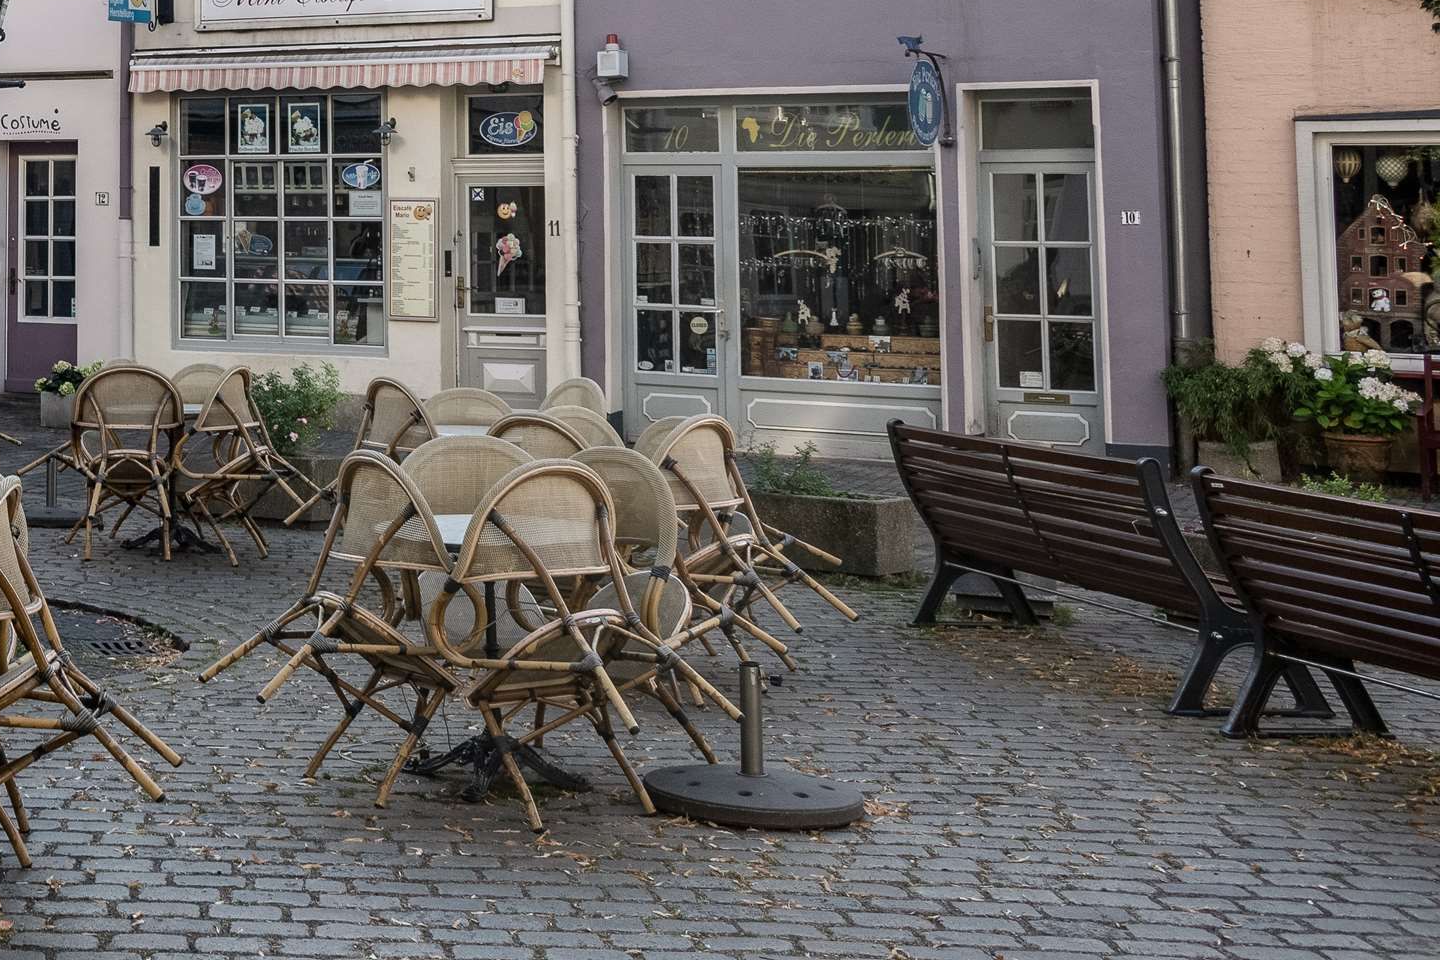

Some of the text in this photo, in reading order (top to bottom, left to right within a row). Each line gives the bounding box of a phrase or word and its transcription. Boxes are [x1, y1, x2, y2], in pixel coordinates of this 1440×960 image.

[488, 117, 514, 136] Eis
[767, 112, 817, 149] Die
[664, 125, 689, 150] 10
[98, 193, 106, 204] 12
[1125, 210, 1136, 224] 10
[547, 220, 561, 237] 11
